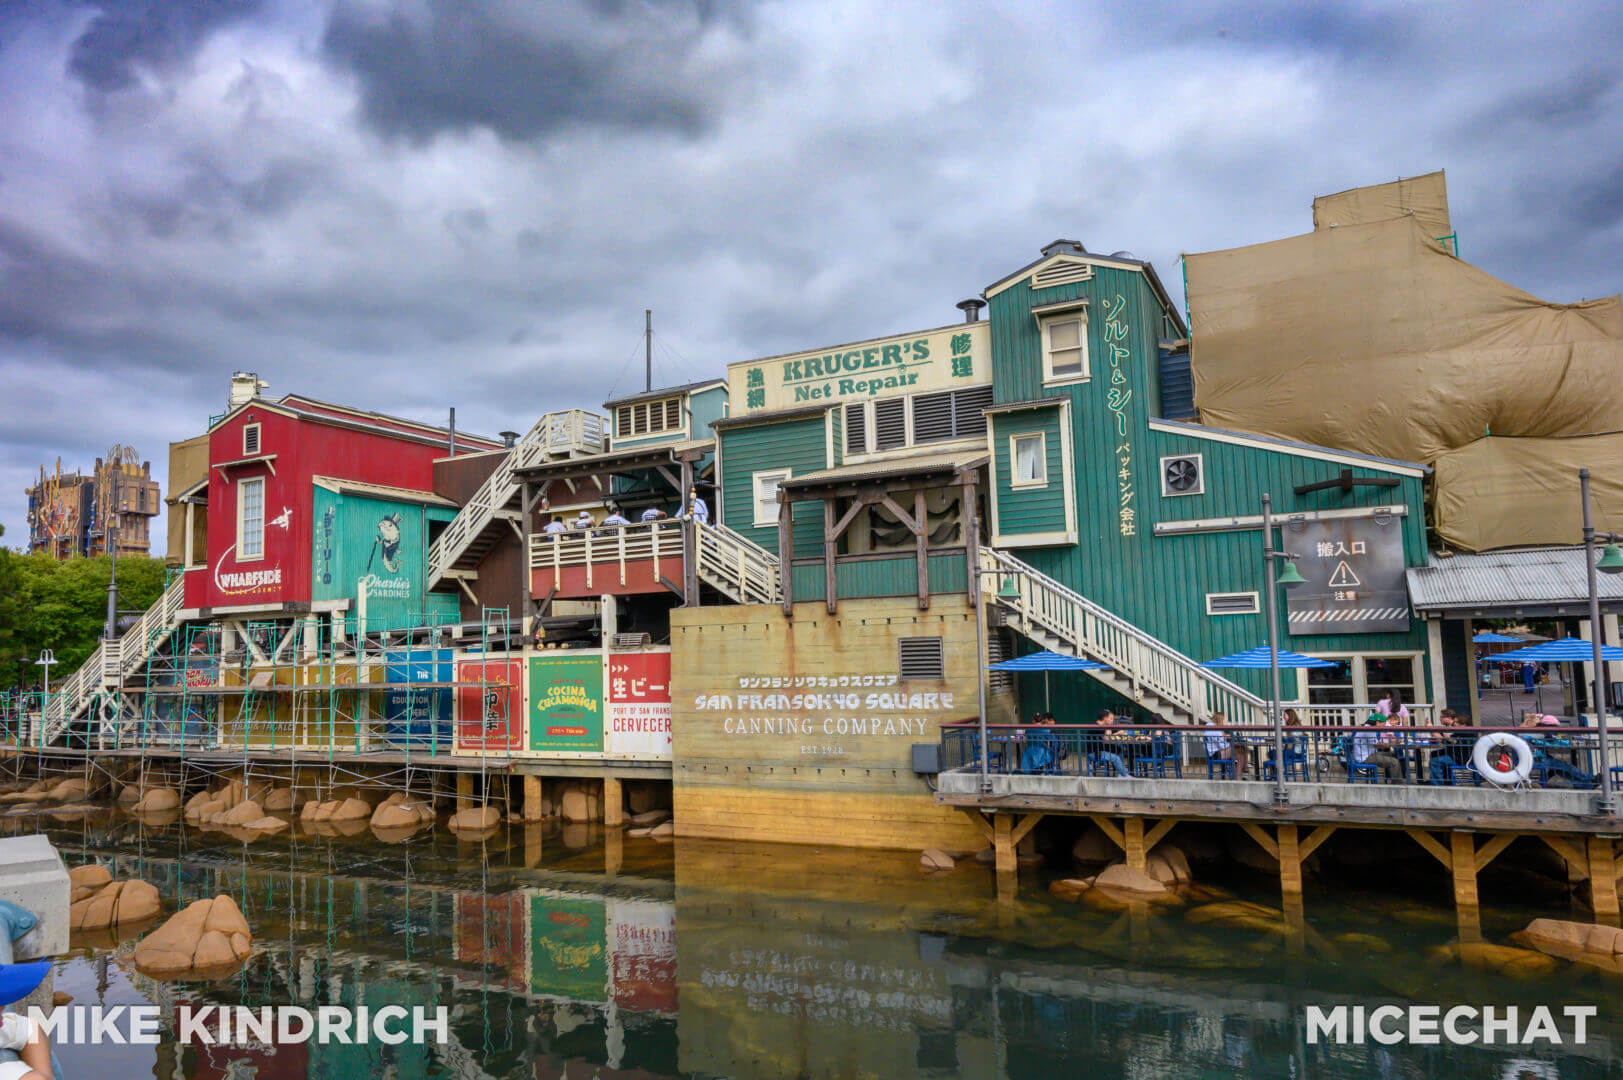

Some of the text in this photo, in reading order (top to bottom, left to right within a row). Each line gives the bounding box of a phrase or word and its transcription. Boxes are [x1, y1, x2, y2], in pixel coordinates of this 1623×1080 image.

[782, 338, 930, 382] KRUGER'S
[950, 333, 974, 378] 修理
[793, 371, 919, 403] Net Repair
[219, 569, 282, 588] WHARFSIDE
[1334, 590, 1356, 601] 注
[547, 686, 586, 698] COCINA
[695, 692, 954, 710] SAN FRANSOKYO SQUARE
[537, 695, 597, 713] CUCAMONGA
[724, 717, 928, 735] CANNING COMPANY
